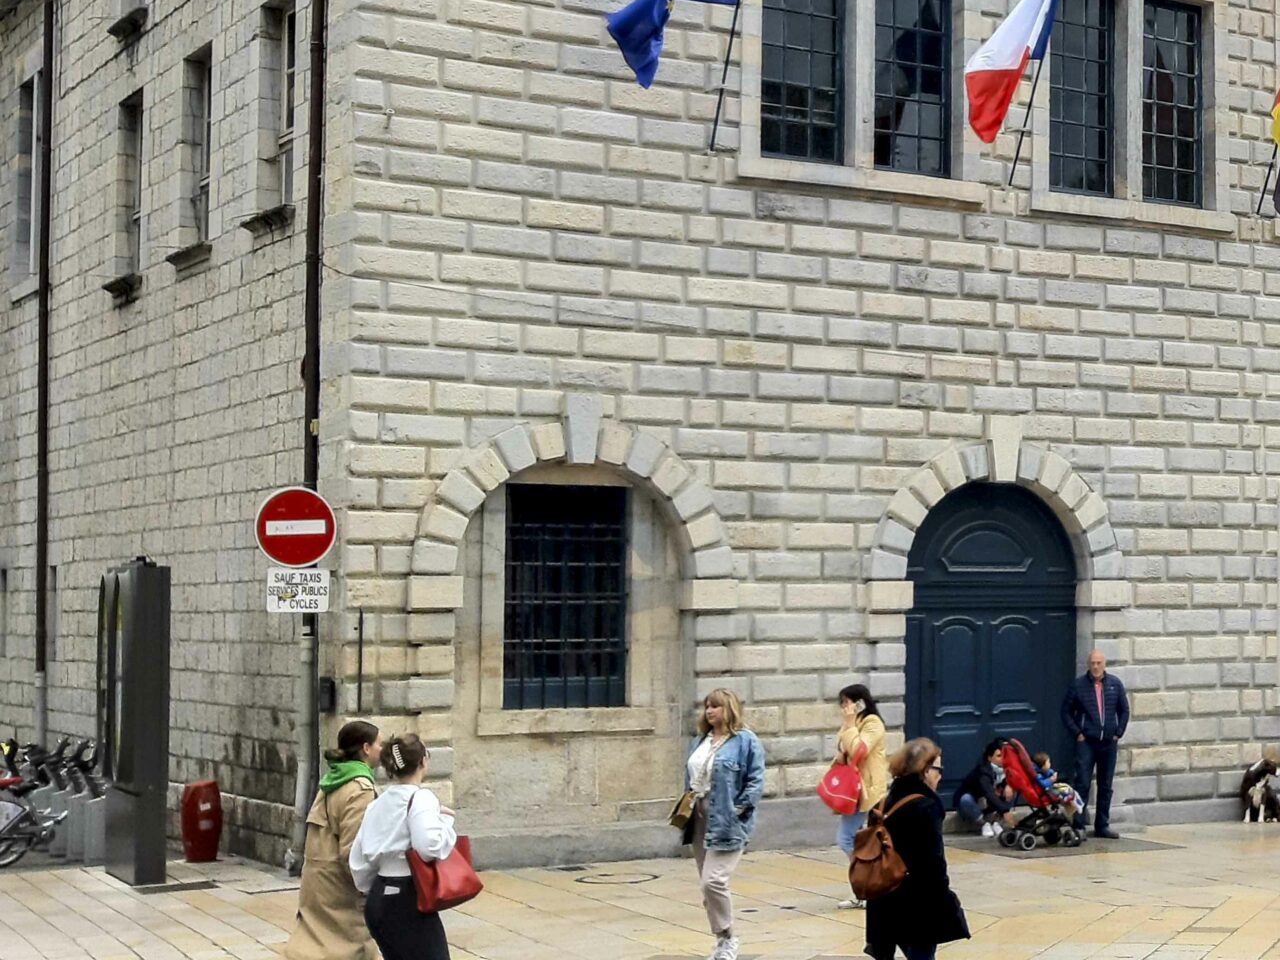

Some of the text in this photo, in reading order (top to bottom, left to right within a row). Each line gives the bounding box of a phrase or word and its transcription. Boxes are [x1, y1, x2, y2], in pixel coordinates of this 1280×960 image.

[274, 572, 322, 583] SAUF TAXIS
[268, 585, 328, 596] SERVICES PUBLICS
[289, 598, 319, 609] CYCLES
